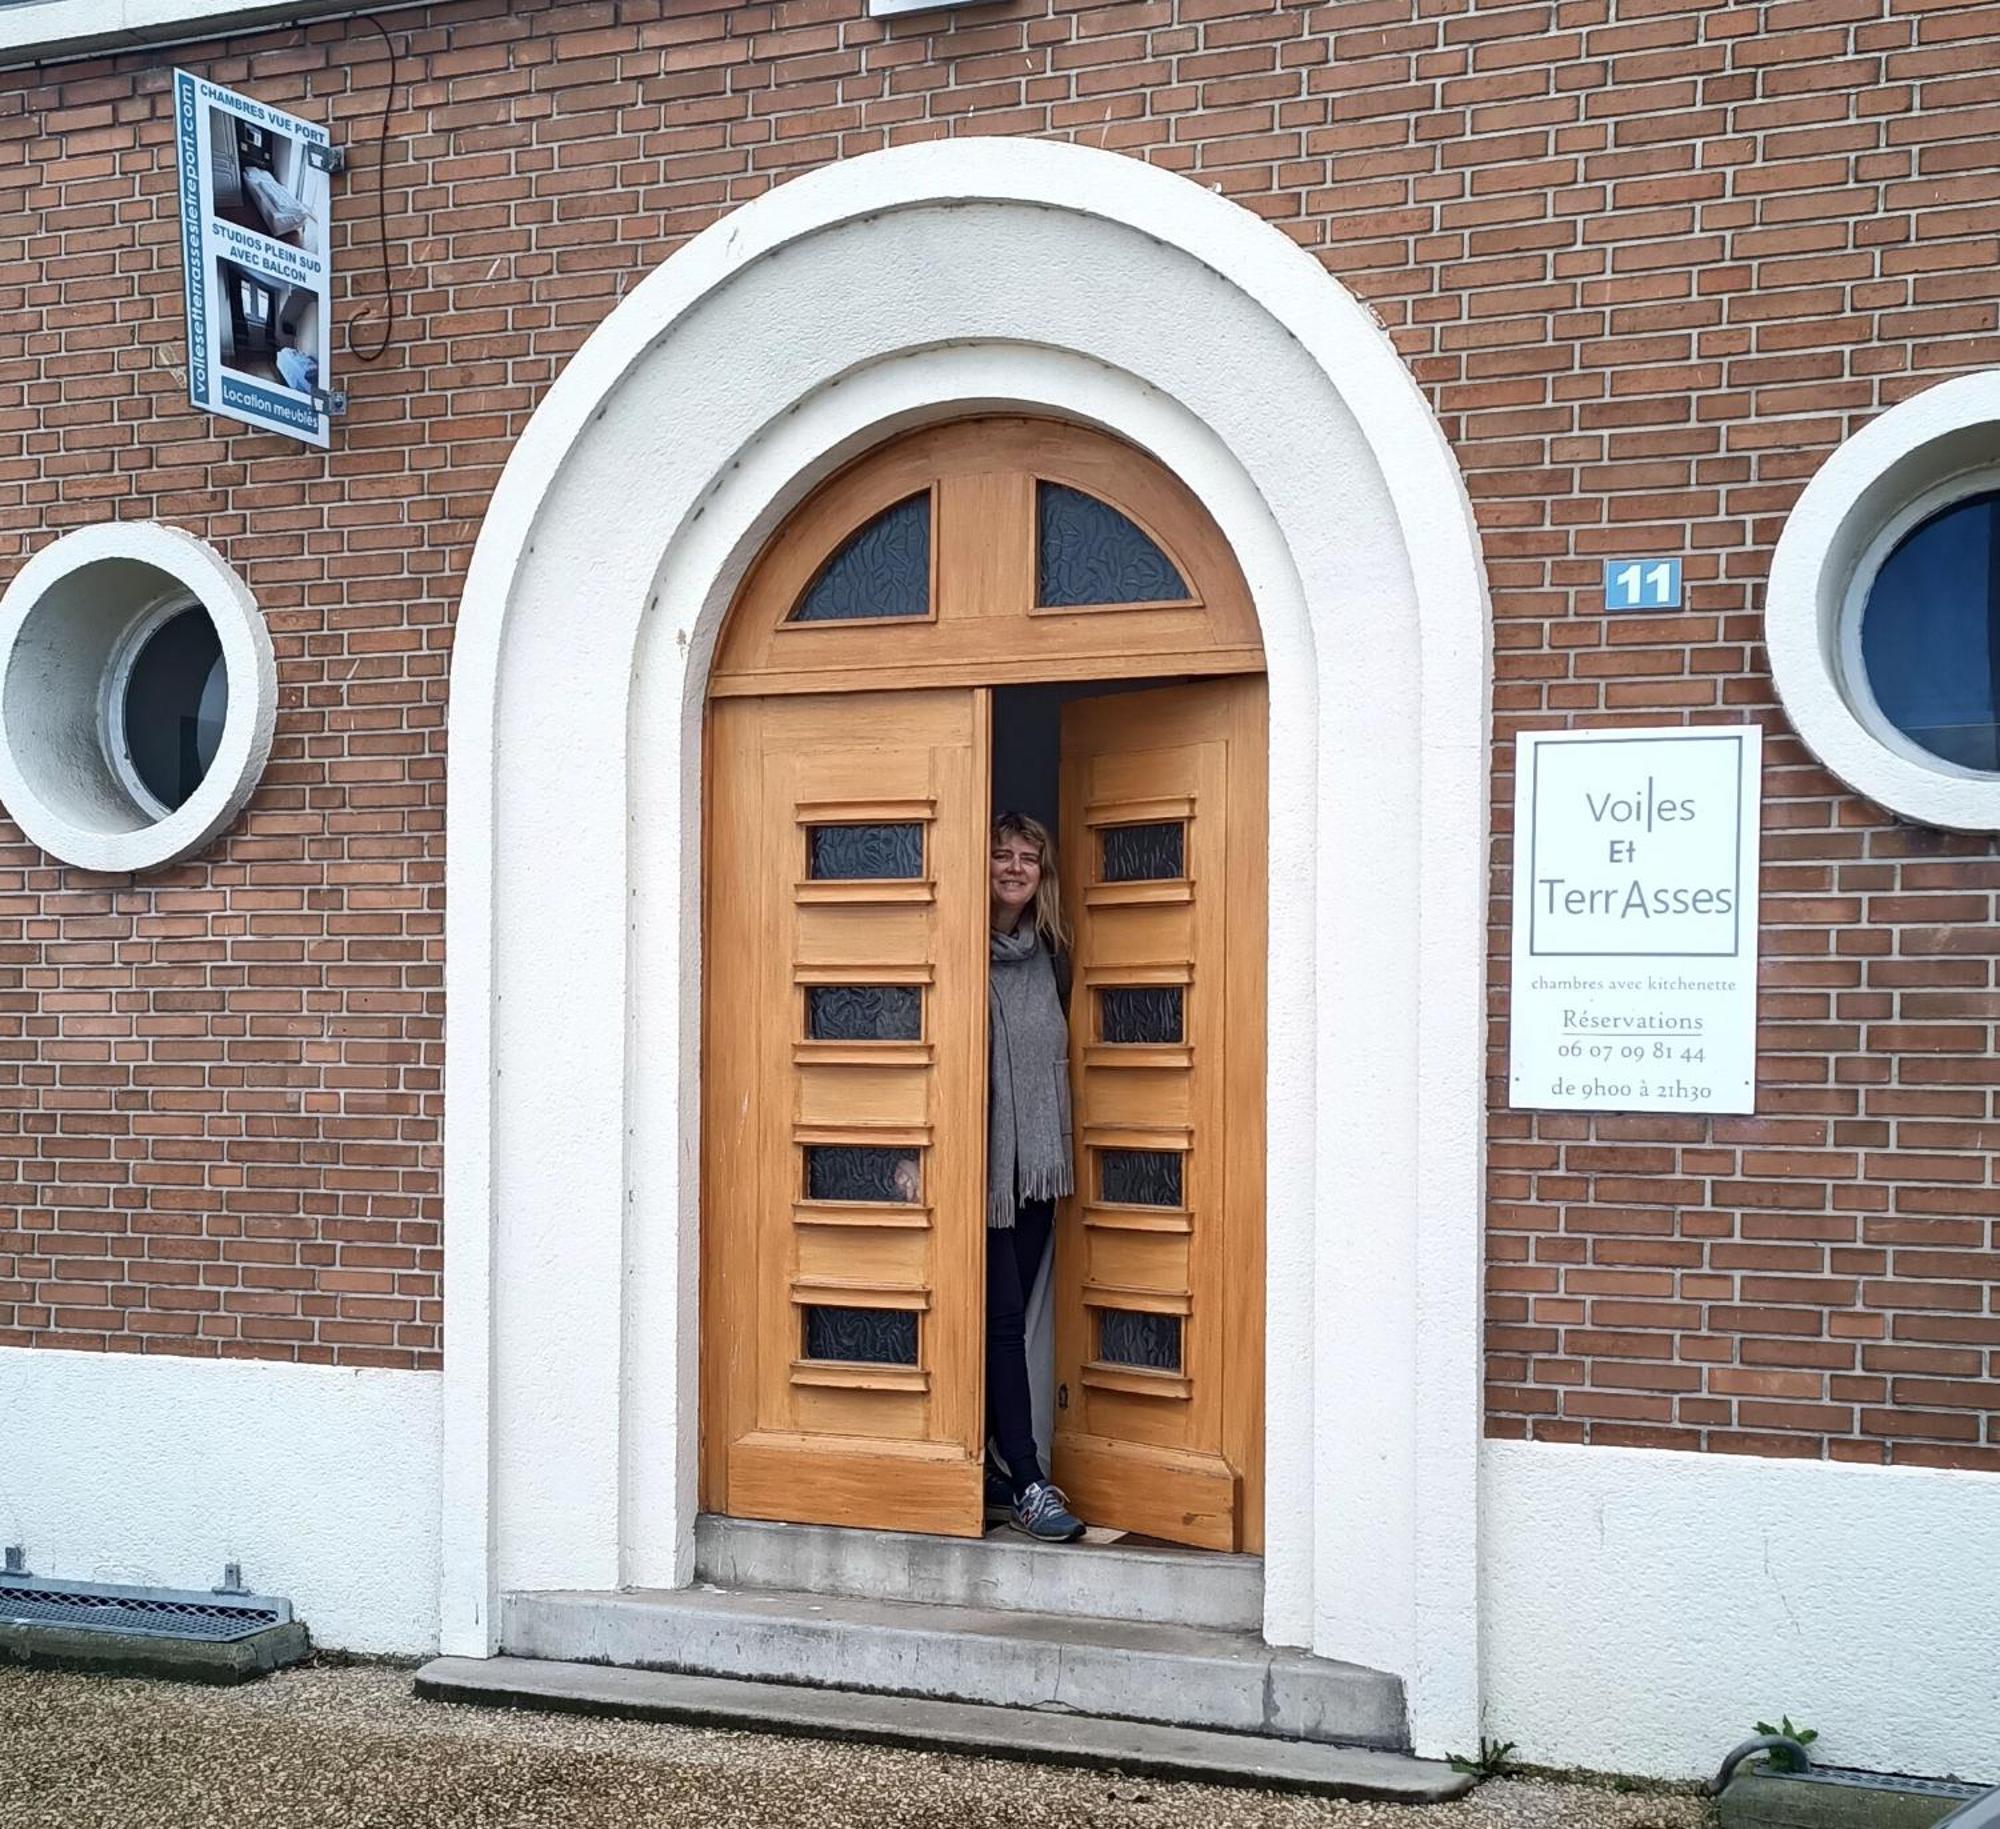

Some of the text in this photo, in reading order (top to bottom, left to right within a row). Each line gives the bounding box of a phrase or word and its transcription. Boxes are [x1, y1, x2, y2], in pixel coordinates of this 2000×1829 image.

[200, 83, 325, 144] CHAMBRES VUE PORT
[212, 223, 321, 273] STUDIOS PLEIN SUD
[230, 246, 306, 283] AVEC BALCON
[223, 385, 317, 428] Location meublés
[1617, 563, 1670, 604] 11
[1586, 776, 1696, 832] Voiles
[1608, 840, 1636, 863] Et
[1538, 879, 1733, 919] TerrAsses
[1531, 976, 1736, 991] chambres avec kitchenette
[1563, 1009, 1704, 1030] Réservations
[1558, 1040, 1705, 1063] 06 07 09 81 44
[1551, 1077, 1712, 1101] de 9h00 à 21h30
